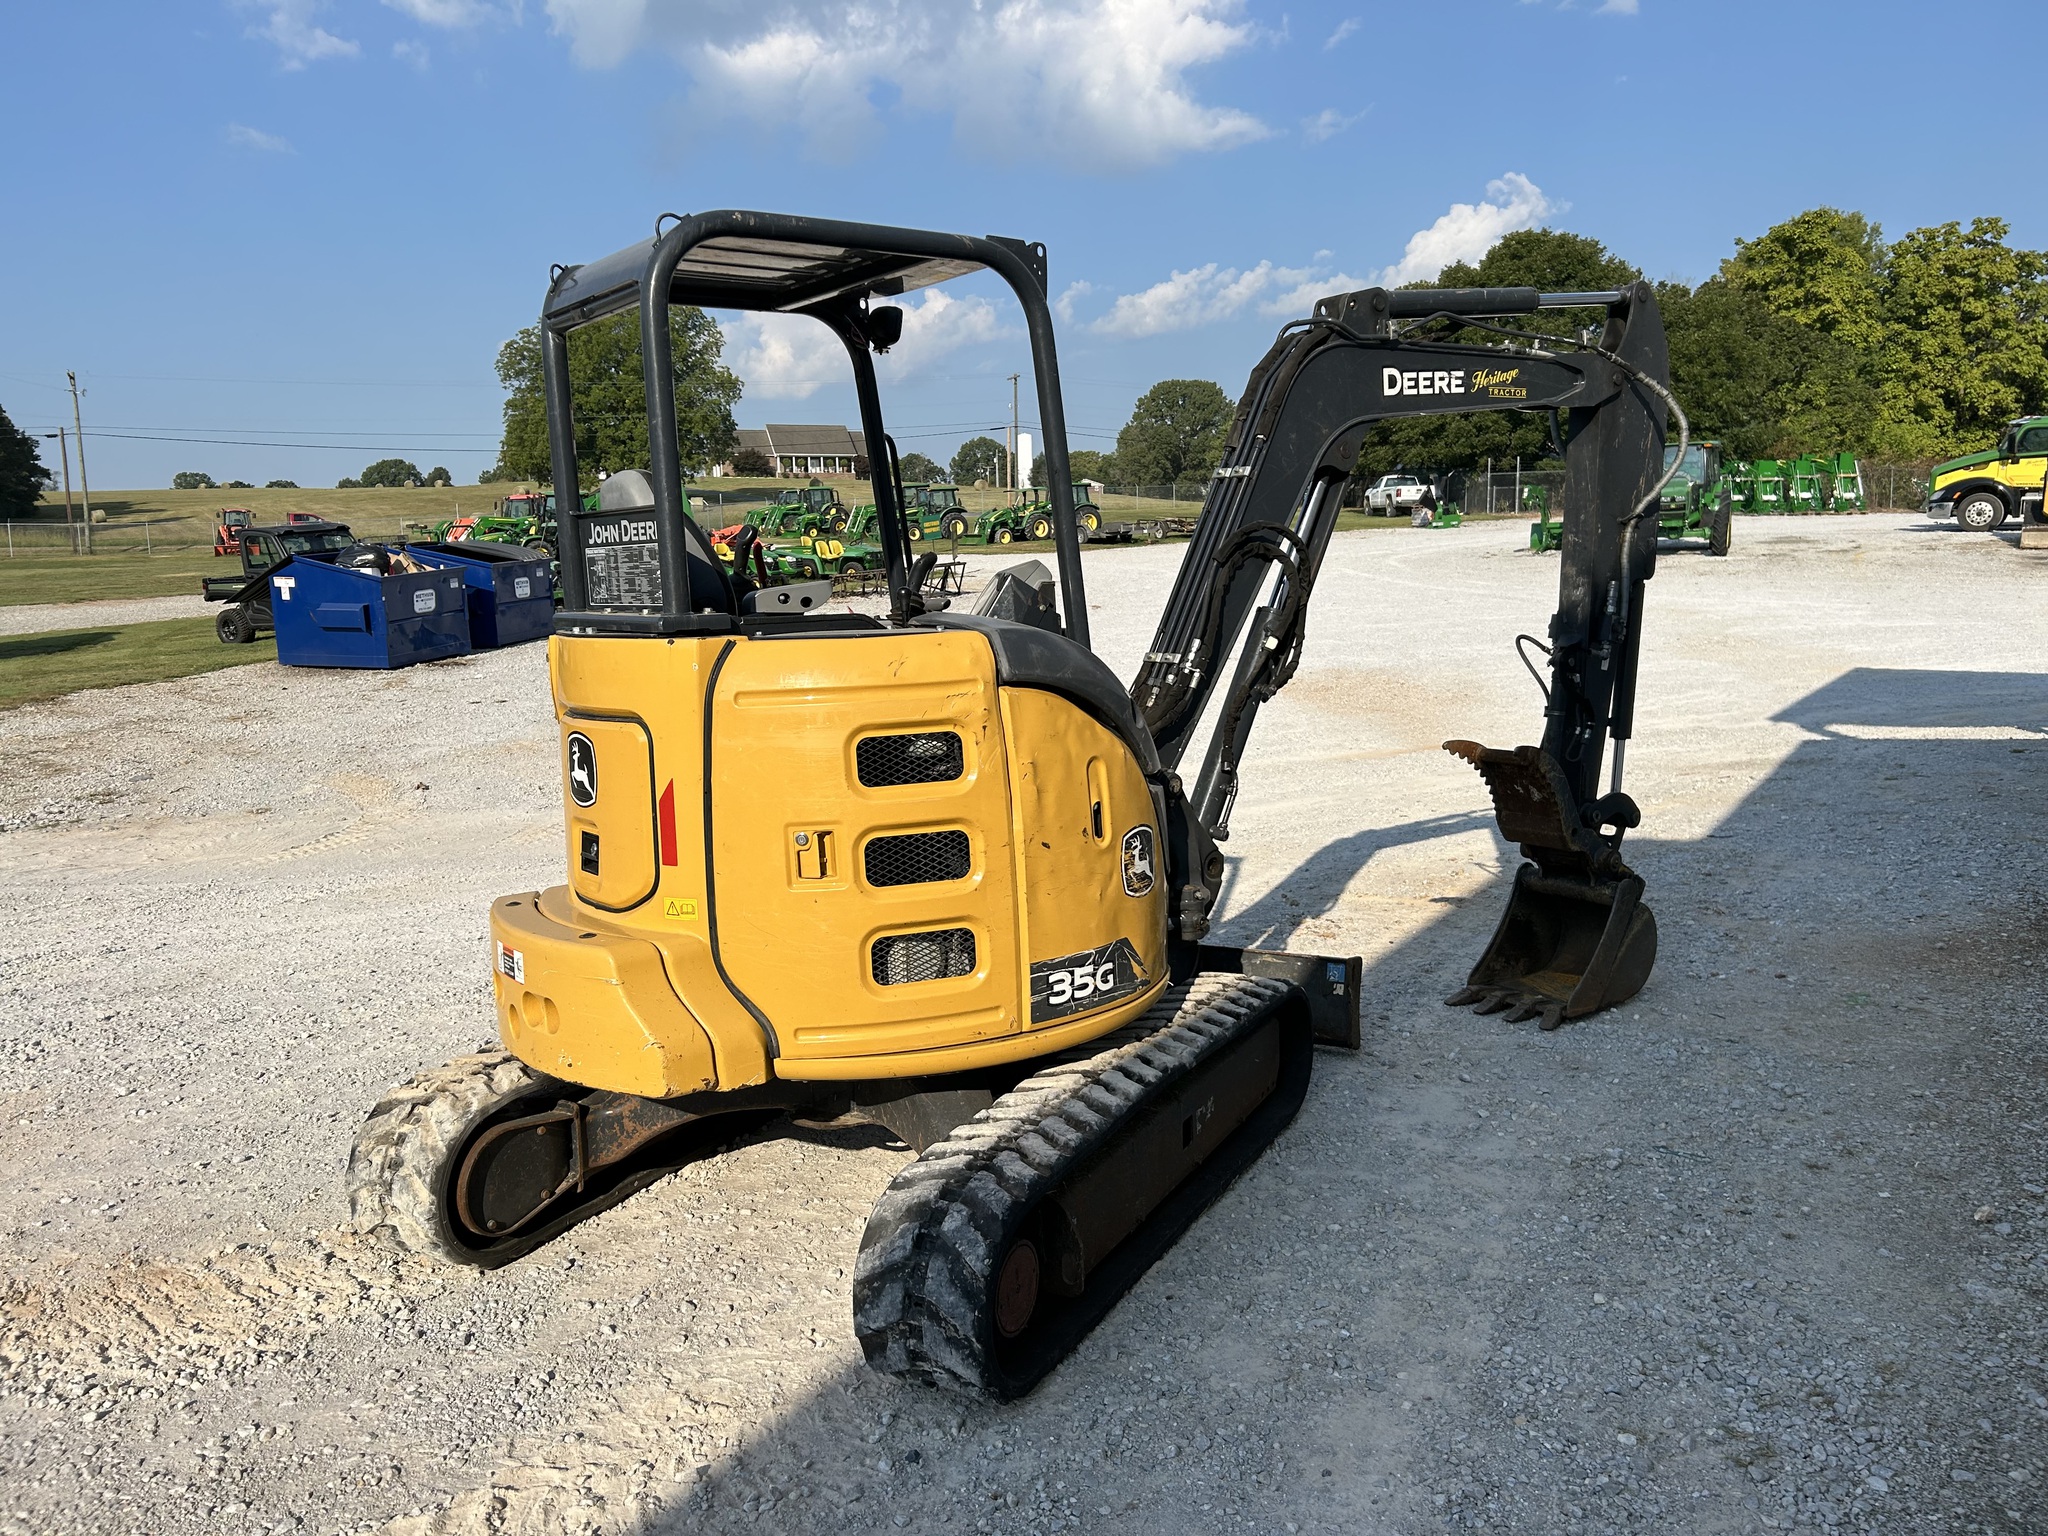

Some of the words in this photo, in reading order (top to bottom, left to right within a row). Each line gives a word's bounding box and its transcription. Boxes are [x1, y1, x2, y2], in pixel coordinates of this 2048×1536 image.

[1383, 367, 1465, 396] DEERE
[1470, 367, 1519, 393] Heritage
[1488, 387, 1527, 398] TRACTOR
[588, 522, 620, 545] JOHN
[1048, 962, 1114, 1005] 35G
